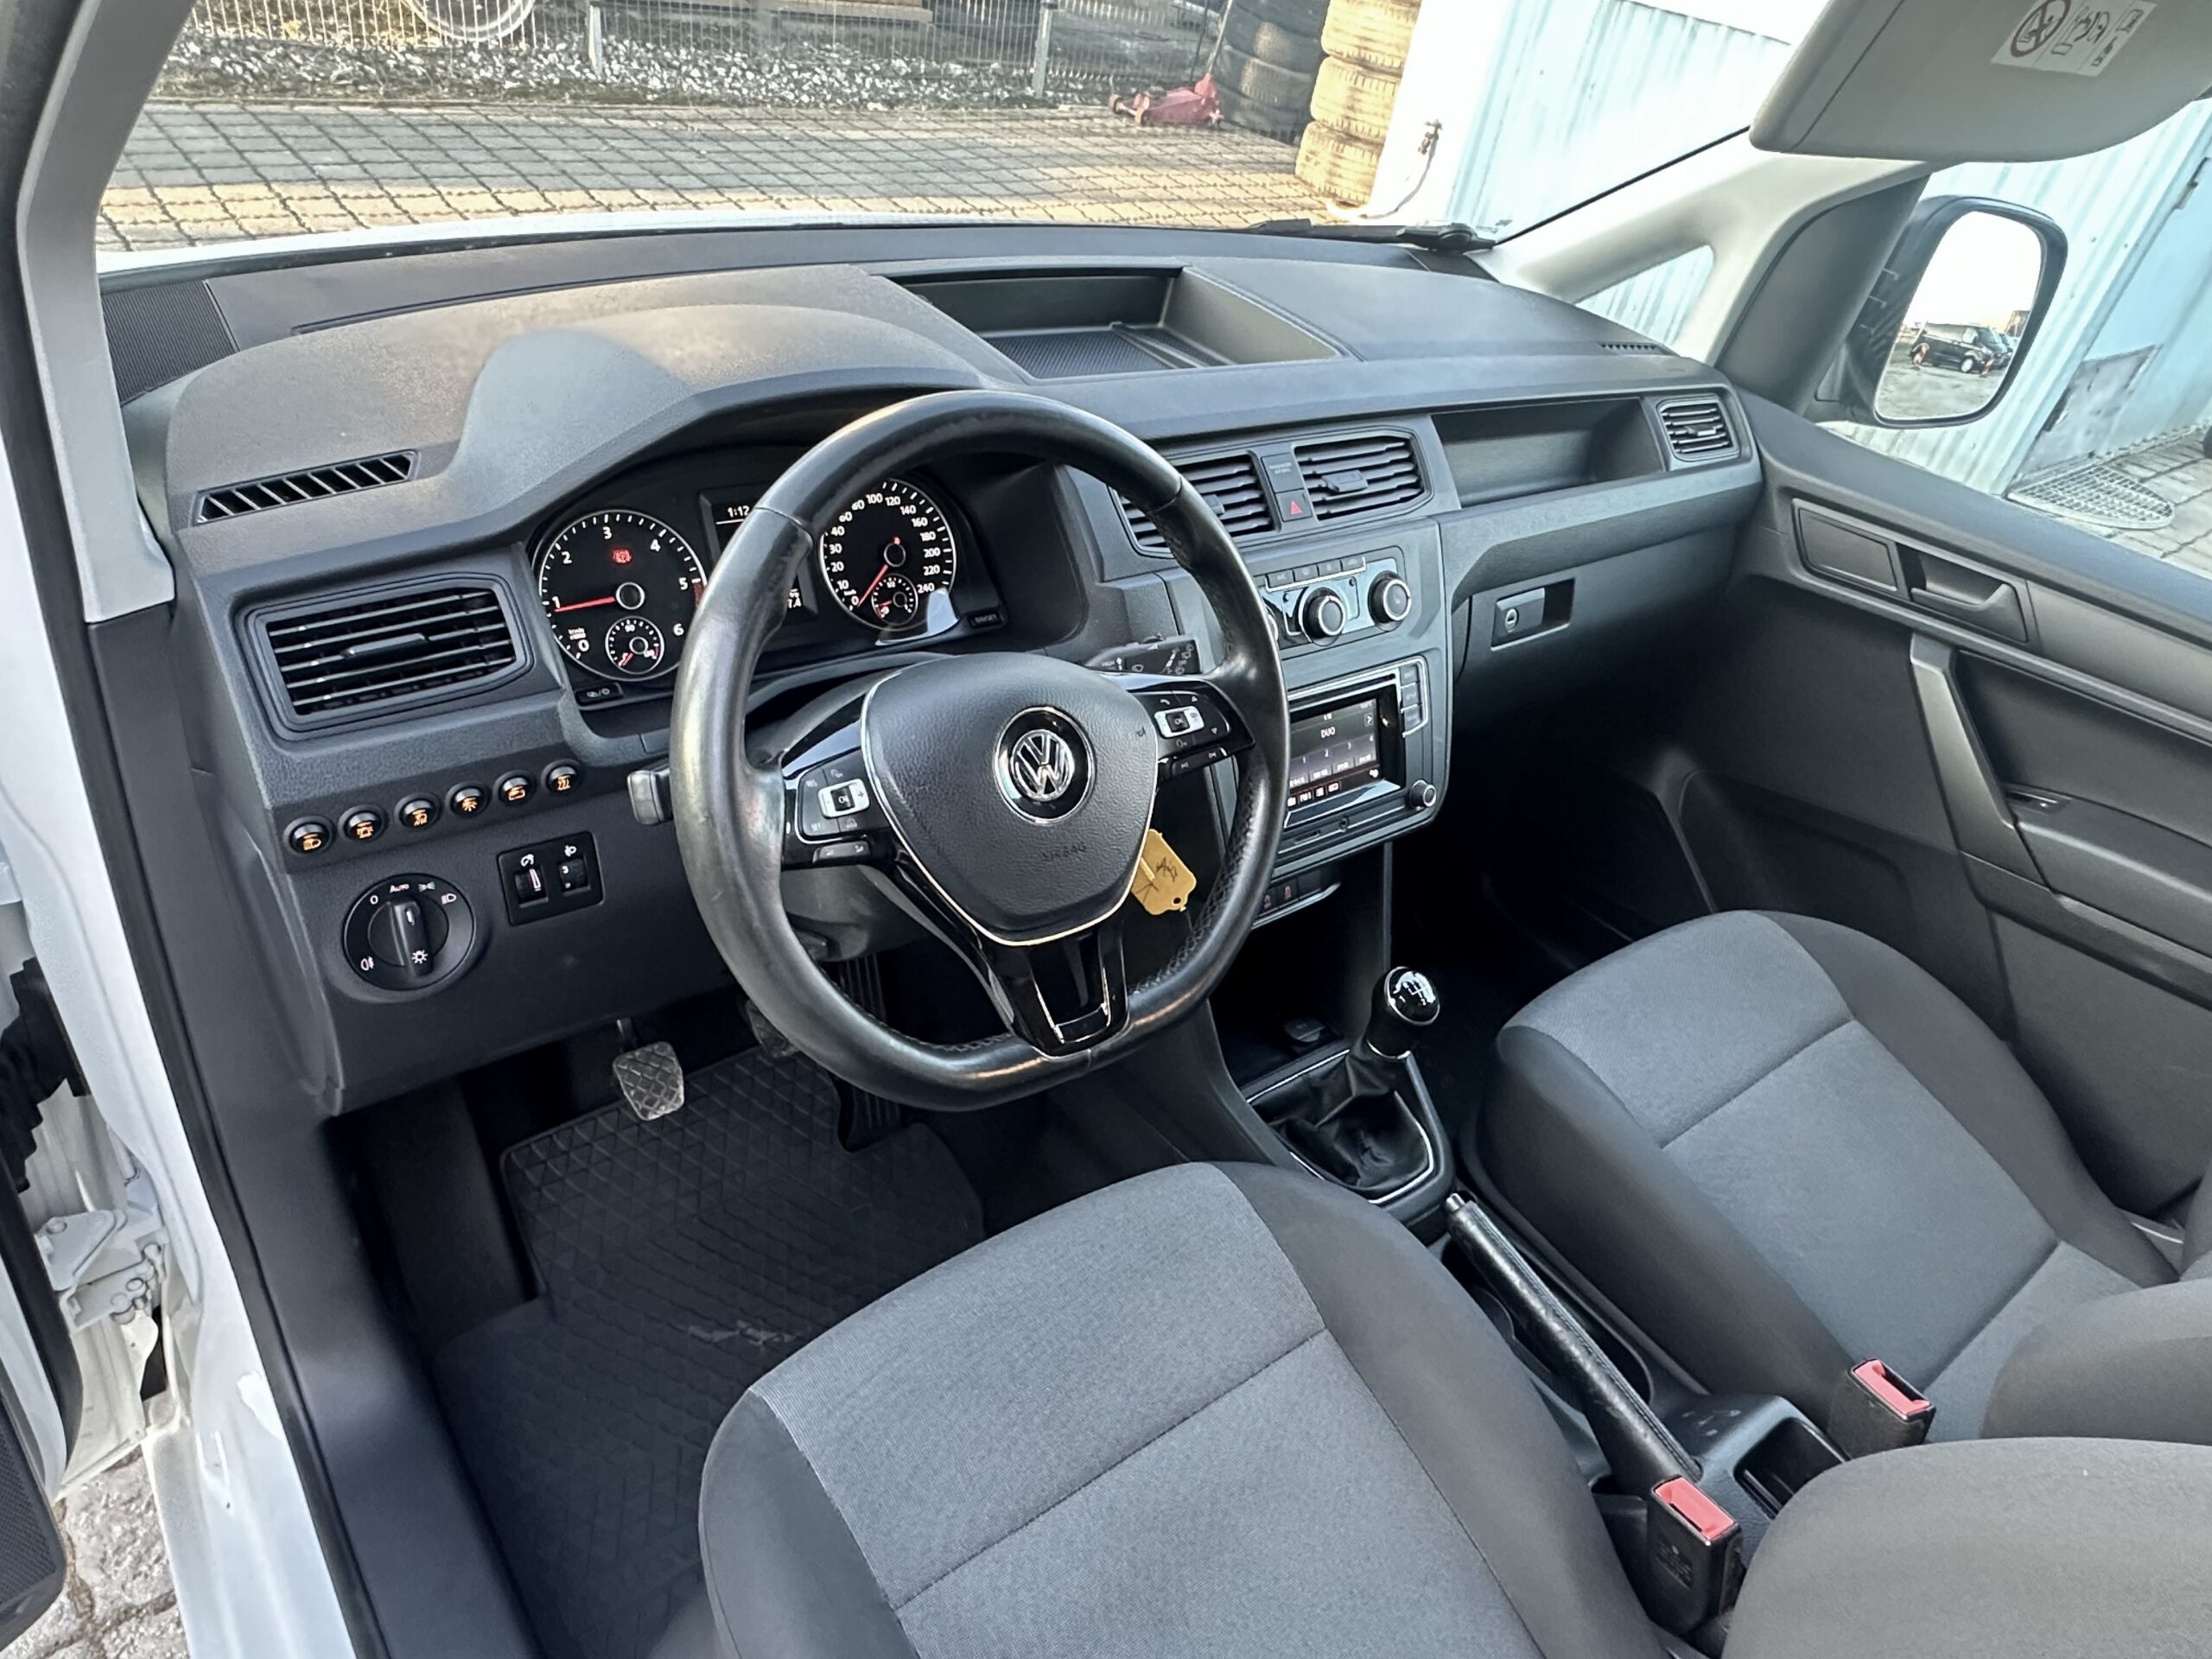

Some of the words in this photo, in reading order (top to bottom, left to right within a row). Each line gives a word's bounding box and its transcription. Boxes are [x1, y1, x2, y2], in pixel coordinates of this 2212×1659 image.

[866, 493, 883, 505] 100
[885, 495, 901, 506] 120
[728, 505, 750, 518] 1:12
[899, 505, 917, 516] 140
[911, 517, 929, 528] 160
[602, 525, 613, 540] 3
[830, 525, 845, 537] 40
[919, 531, 937, 542] 180
[650, 538, 661, 552] 4
[829, 543, 842, 555] 30
[562, 550, 572, 564] 2
[923, 547, 941, 558] 200
[830, 562, 845, 572] 20
[923, 564, 941, 576] 220
[678, 576, 689, 591] 5
[836, 579, 849, 591] 10
[917, 582, 935, 594] 240
[850, 595, 860, 606] 0
[673, 622, 684, 637] 6
[578, 639, 589, 652] 0
[1320, 726, 1336, 739] DUO
